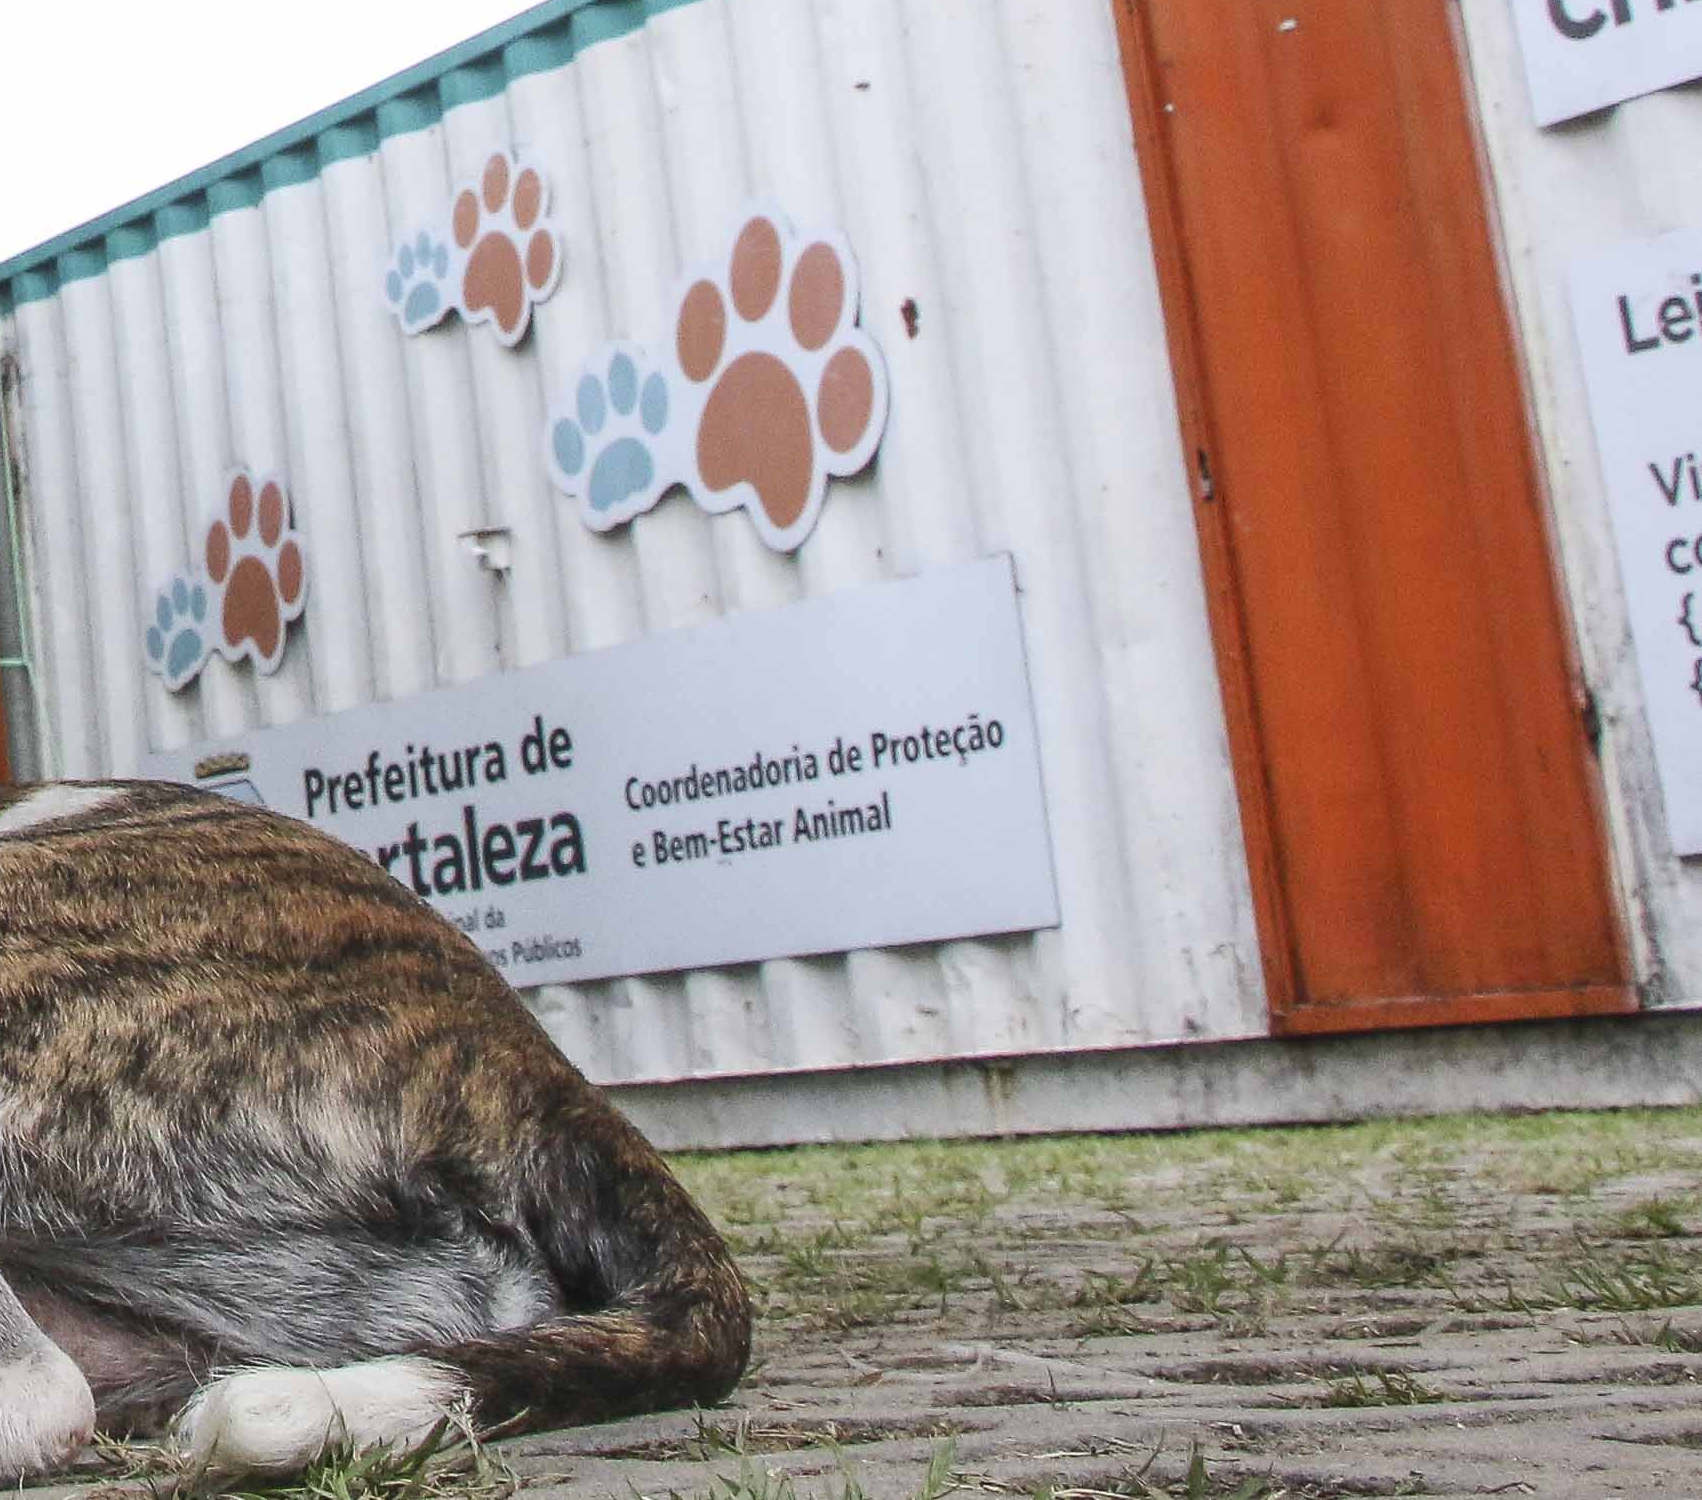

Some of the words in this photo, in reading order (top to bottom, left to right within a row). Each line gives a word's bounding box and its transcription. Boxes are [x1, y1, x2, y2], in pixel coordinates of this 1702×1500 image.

[304, 742, 506, 818] Prefeitura
[521, 715, 572, 775] de
[625, 745, 818, 810] Coordenadoria
[829, 737, 862, 775] de
[871, 713, 1004, 767] Proteção
[378, 804, 585, 897] rtaleza
[632, 842, 646, 867] e
[653, 819, 784, 864] Bem-Estar
[794, 791, 892, 843] Animal
